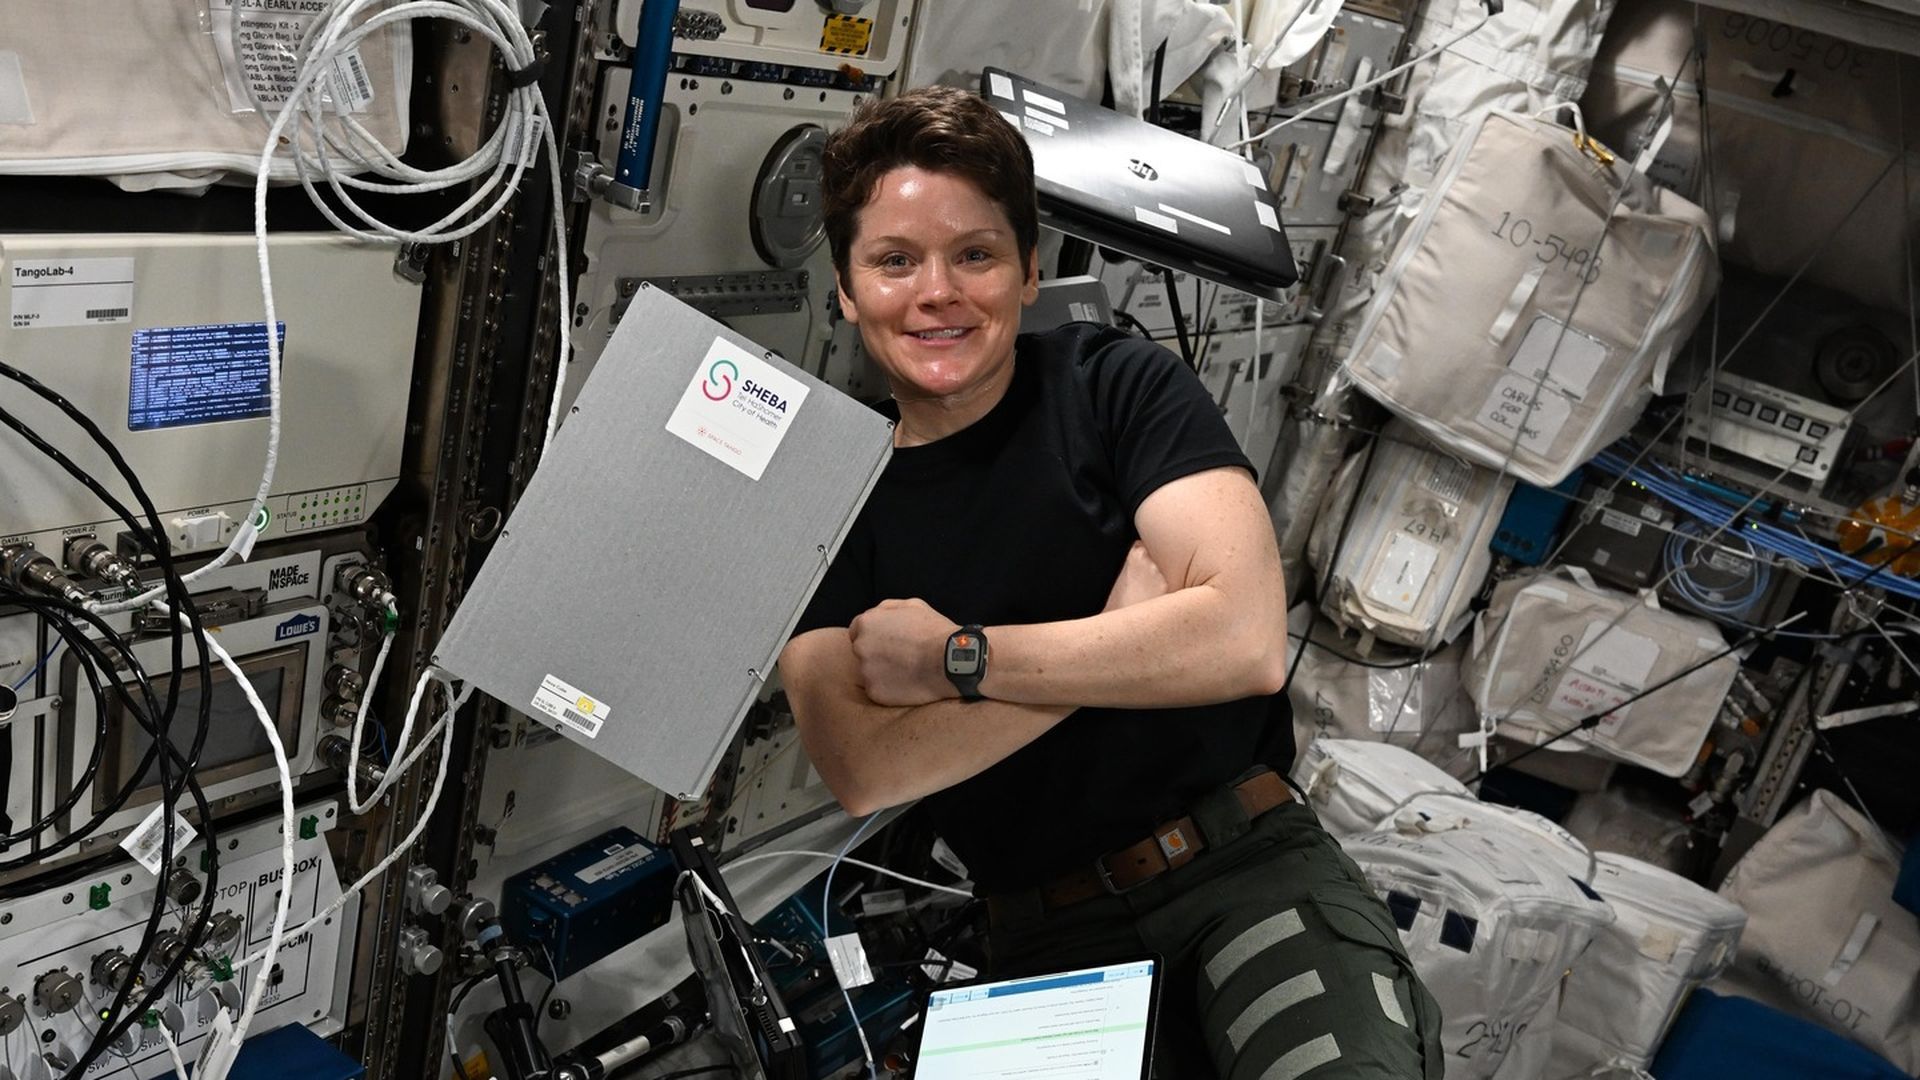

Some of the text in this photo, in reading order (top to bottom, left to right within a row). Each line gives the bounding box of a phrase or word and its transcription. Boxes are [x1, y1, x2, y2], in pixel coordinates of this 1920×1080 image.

[15, 266, 74, 279] TangoLab-4
[742, 380, 787, 413] SHEBA
[732, 400, 747, 412] City
[756, 412, 778, 429] Health
[188, 509, 210, 517] POWER
[62, 527, 86, 536] POWER
[270, 565, 300, 579] MADE
[280, 573, 309, 589] SPACE
[280, 620, 316, 638] LOWE'S
